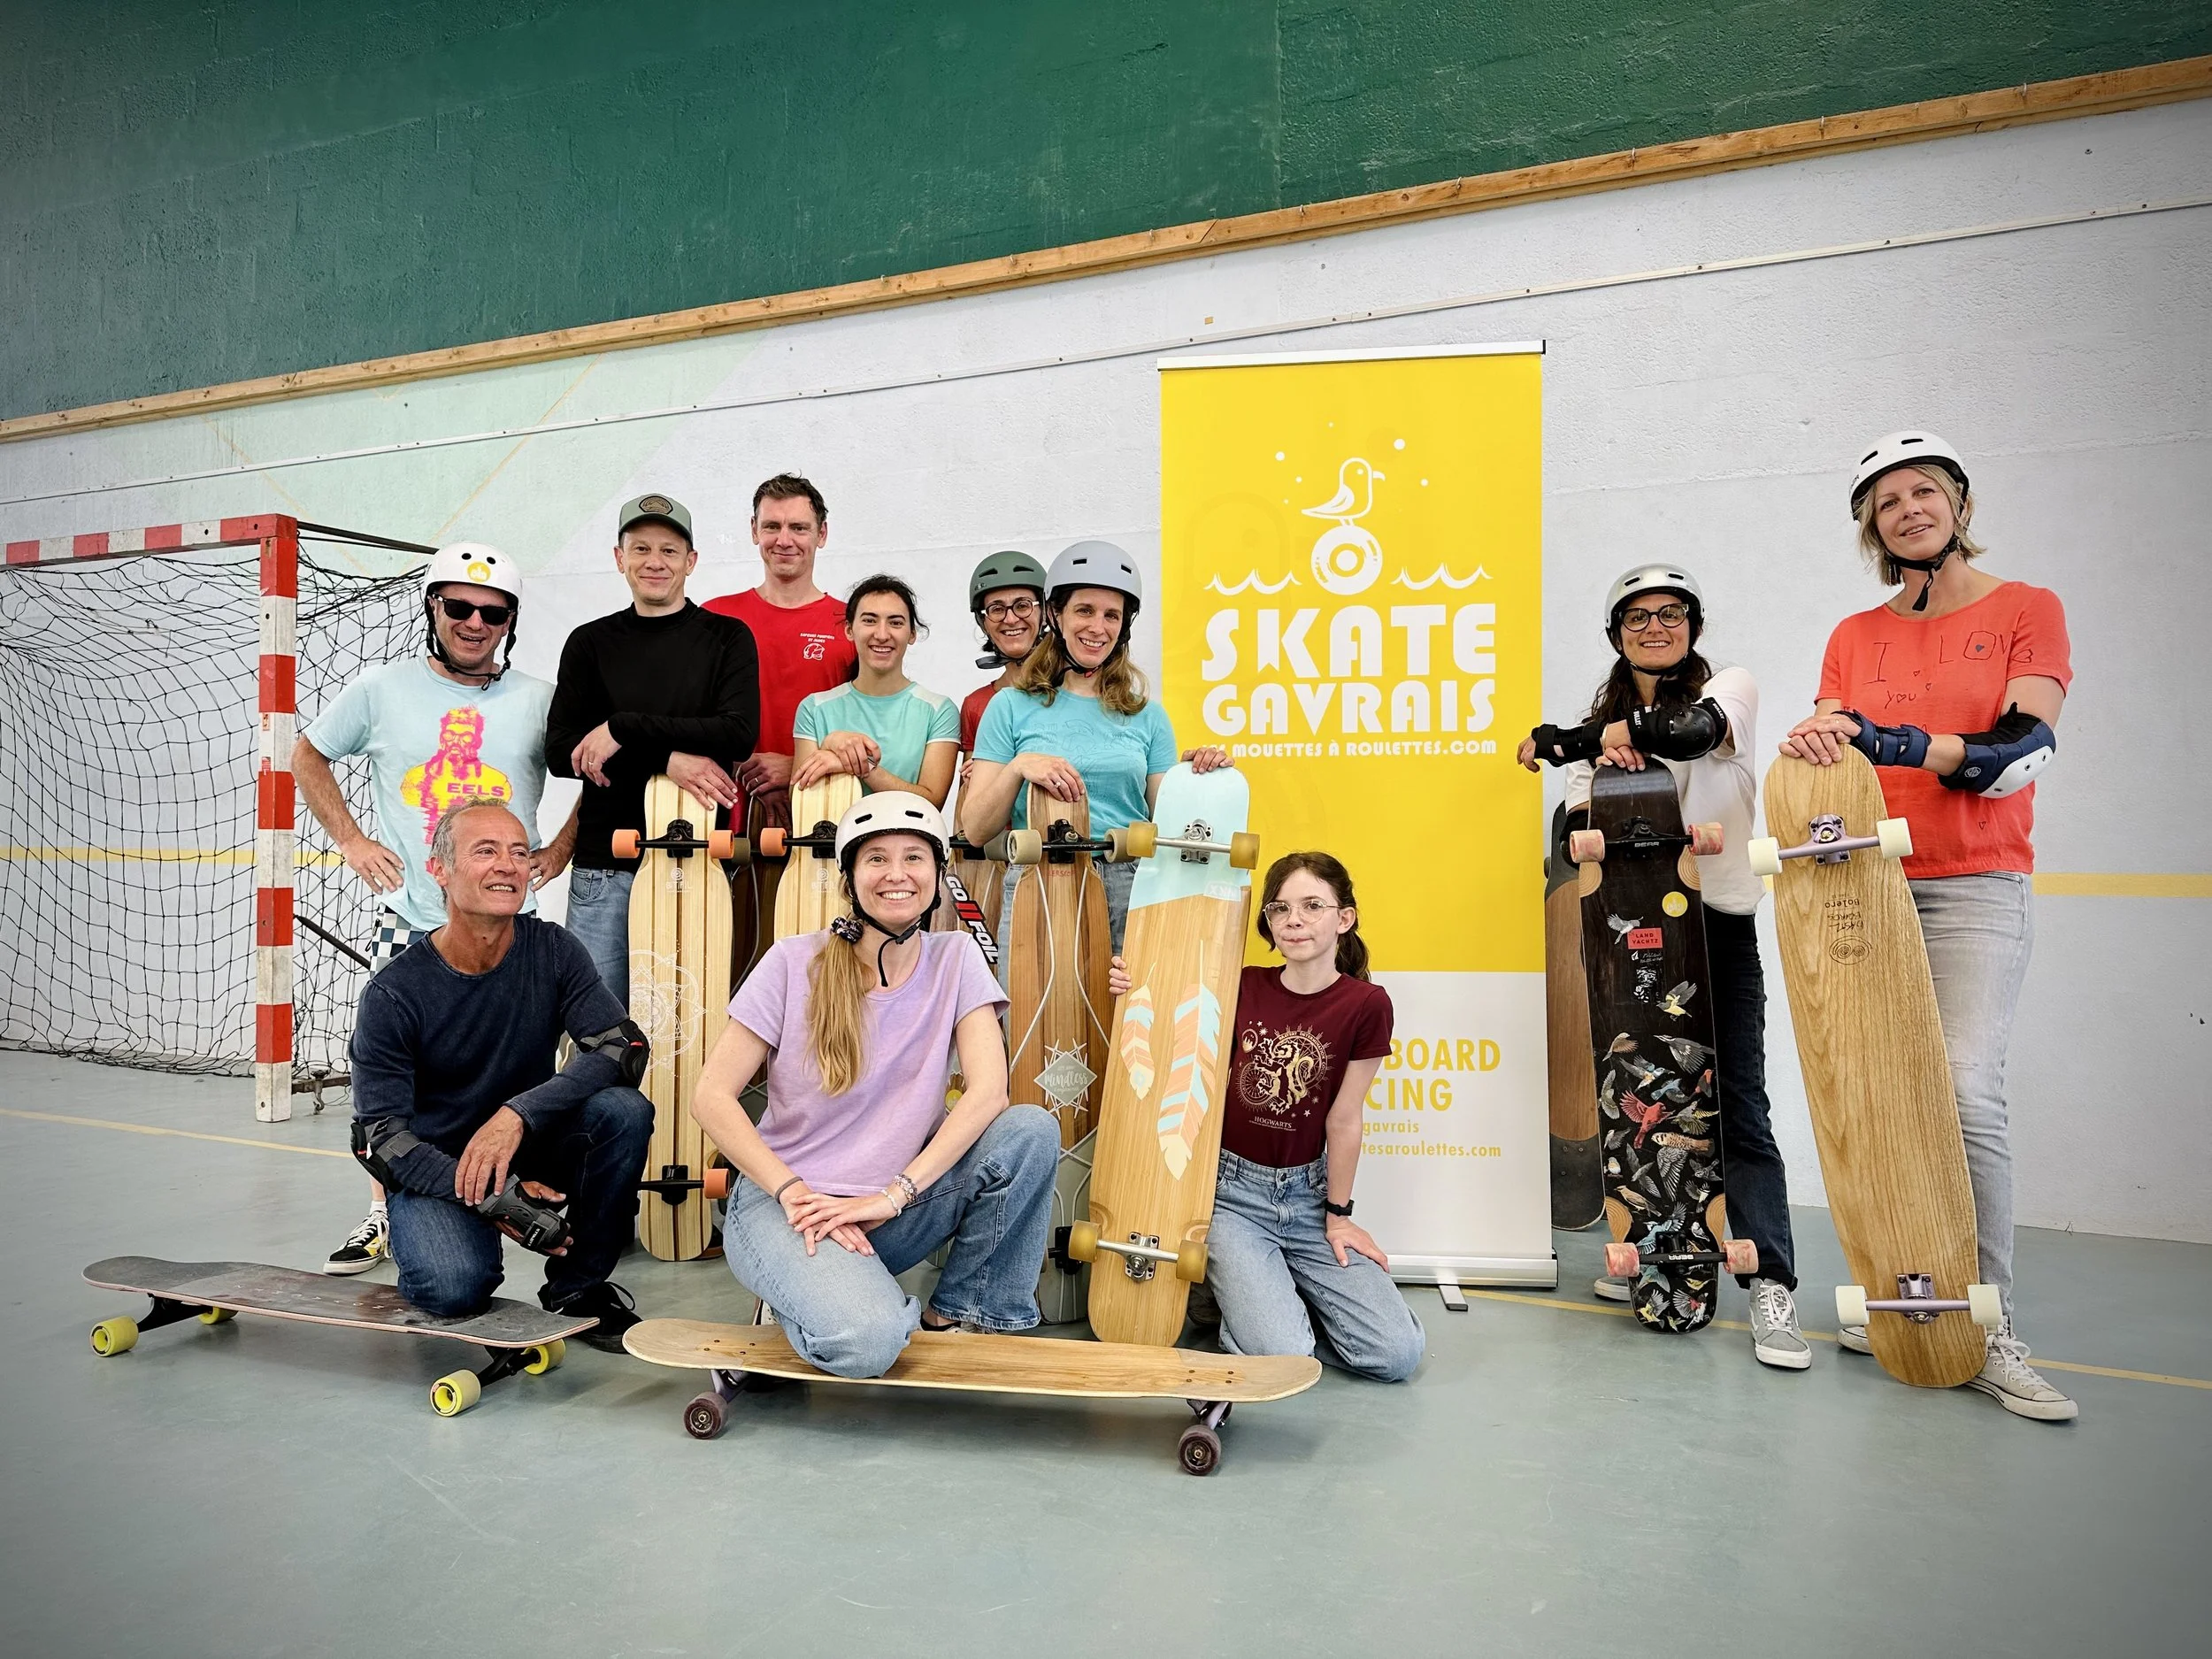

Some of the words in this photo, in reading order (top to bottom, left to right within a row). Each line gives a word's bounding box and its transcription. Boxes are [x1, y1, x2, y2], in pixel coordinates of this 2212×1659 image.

[1202, 603, 1496, 681] SKATE
[1202, 679, 1495, 737] GAVRAIS
[1232, 742, 1323, 757] MOUETTES
[1328, 739, 1340, 757] À
[1346, 740, 1497, 757] ROULETTES.COM
[447, 782, 504, 796] EELS
[1824, 898, 1860, 909] Bolero
[946, 876, 969, 902] GO
[968, 920, 998, 963] FOIL
[1383, 1038, 1502, 1071] BOARD
[1044, 1071, 1088, 1088] Mindless
[1254, 1116, 1293, 1129] HOGWARTS
[1362, 1119, 1420, 1136] gavrais
[1362, 1141, 1502, 1157] tesaroulettes.com
